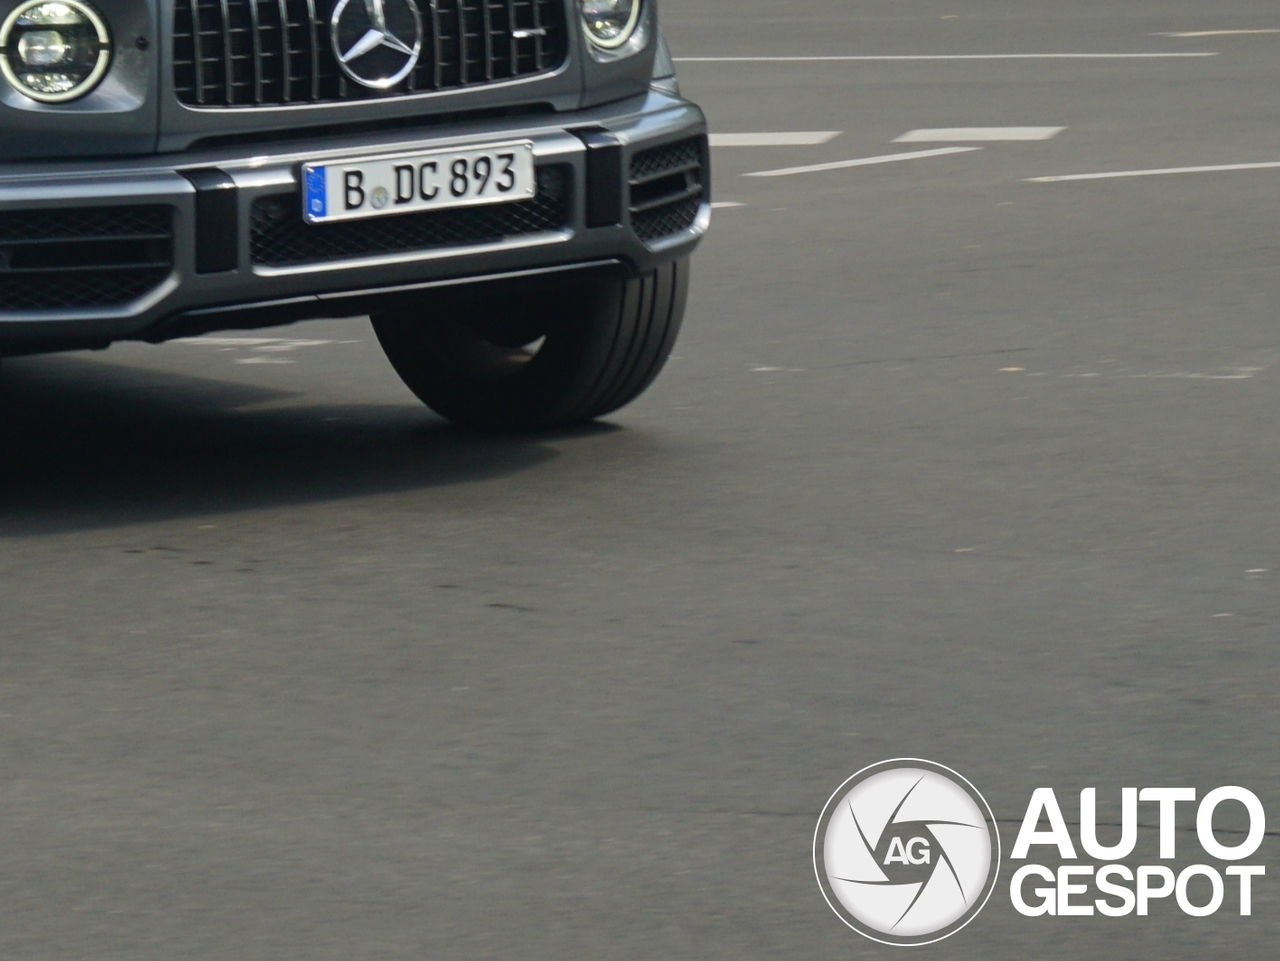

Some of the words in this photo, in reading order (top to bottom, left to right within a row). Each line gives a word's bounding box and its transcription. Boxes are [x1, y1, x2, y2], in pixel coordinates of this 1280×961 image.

[344, 168, 366, 211] B
[394, 161, 439, 205] DC
[450, 152, 516, 197] 893
